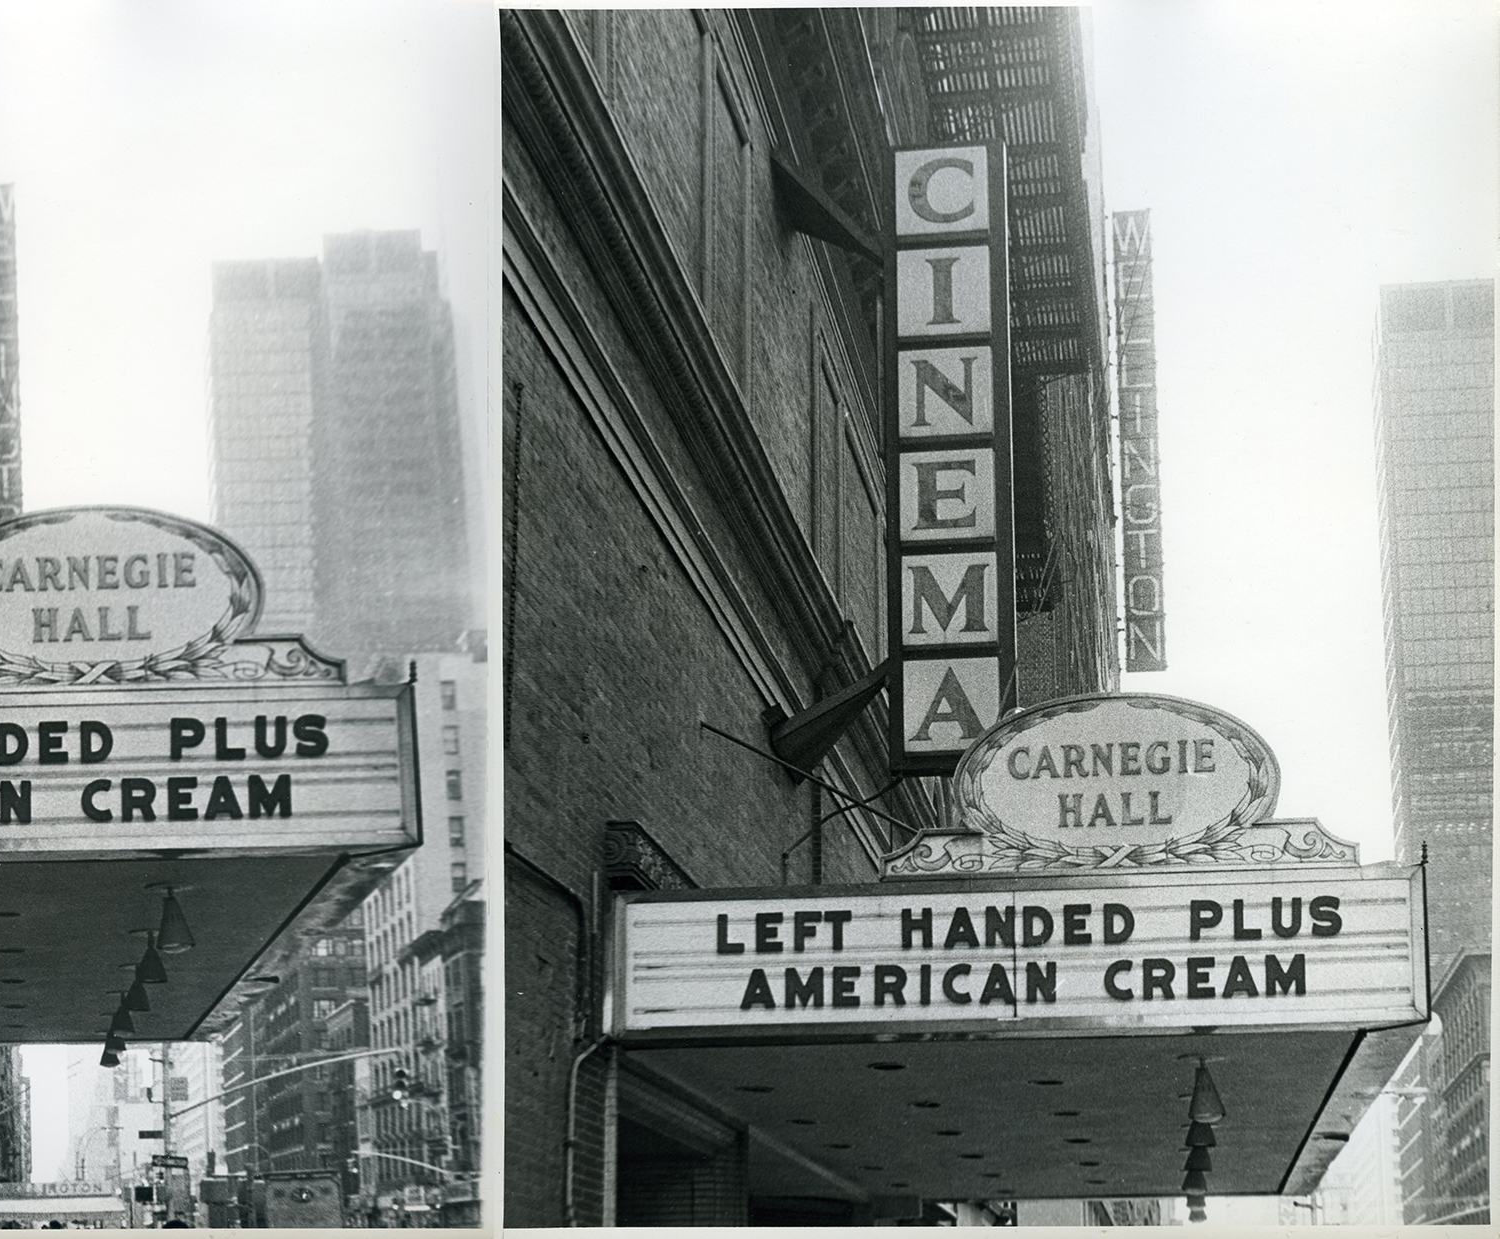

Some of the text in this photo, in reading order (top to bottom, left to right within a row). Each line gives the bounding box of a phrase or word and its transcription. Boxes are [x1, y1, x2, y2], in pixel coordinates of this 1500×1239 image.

[907, 157, 990, 742] CINEMA
[1112, 211, 1164, 660] WELLINGTON
[32, 605, 152, 644] HALL
[168, 714, 329, 763] PLUS
[1007, 739, 1217, 781] CARNEGIE
[81, 774, 293, 823] CREAM
[1057, 791, 1173, 828] HALL
[716, 895, 1343, 955] LEFT HANDED PLUS
[740, 953, 1307, 1010] AMERICAN CREAM
